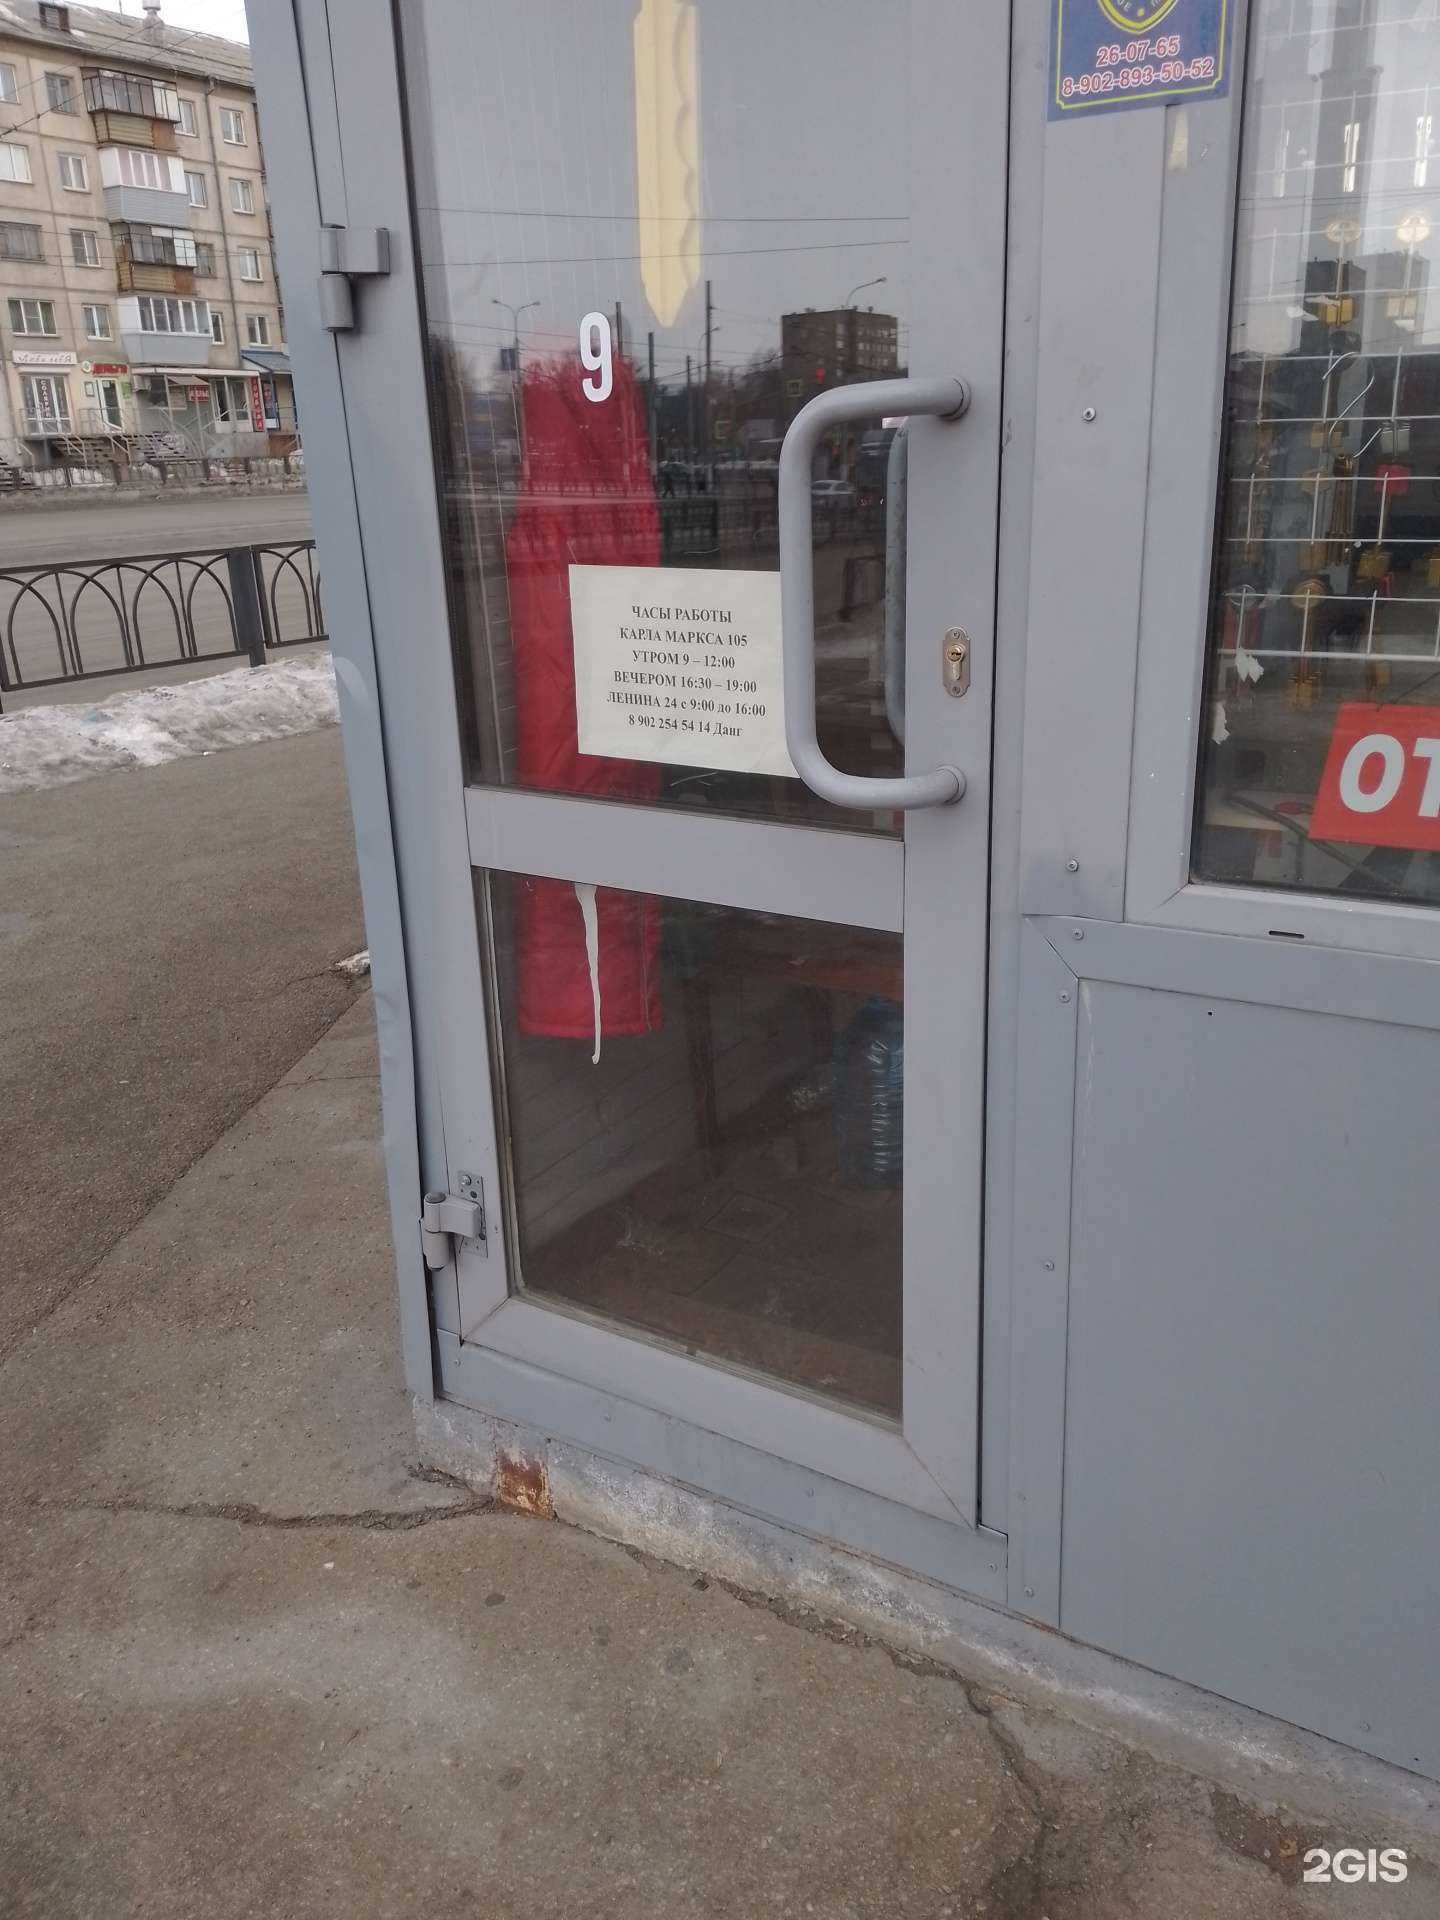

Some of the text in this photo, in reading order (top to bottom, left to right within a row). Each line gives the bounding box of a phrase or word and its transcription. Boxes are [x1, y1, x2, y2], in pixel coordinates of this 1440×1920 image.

[1096, 35, 1180, 67] 26-07-65
[1062, 56, 1214, 97] 8-902-893-50-52
[579, 312, 613, 403] 9
[632, 606, 732, 623] ЧАСЫ РАБОТЫ
[620, 627, 748, 646] КАРЛА МАРКСА 105
[632, 651, 679, 665] УТРОМ
[683, 654, 689, 665] 9
[704, 655, 735, 668] 12:00
[614, 671, 676, 687] ВЕЧЕРОМ
[681, 676, 712, 689] 16:30
[727, 679, 757, 692] 19:00
[607, 692, 661, 708] ЛЕНИНА
[664, 697, 677, 708] 24
[690, 699, 715, 712] 9:00
[717, 704, 731, 714] до
[736, 703, 766, 716] 16:00
[629, 714, 743, 737] 8 902 254 54 14 Данг
